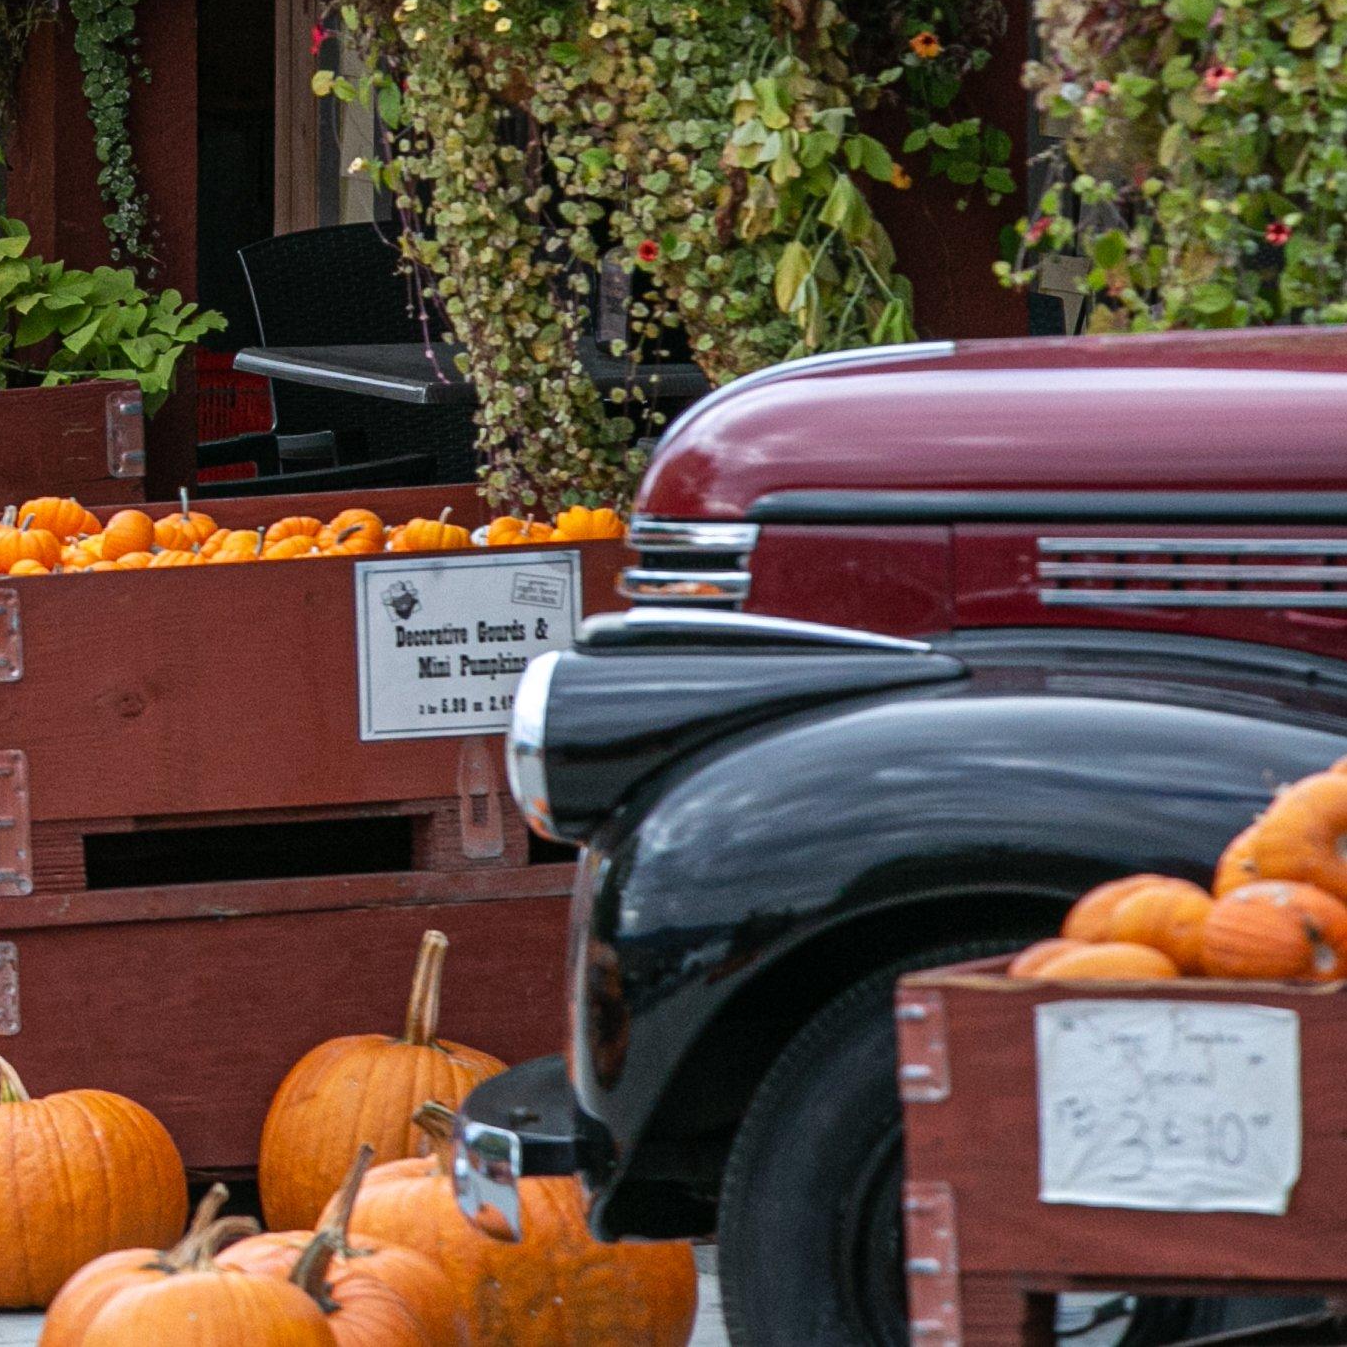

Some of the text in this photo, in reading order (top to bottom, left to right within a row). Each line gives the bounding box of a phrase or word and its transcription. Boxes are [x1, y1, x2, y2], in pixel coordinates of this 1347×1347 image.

[395, 616, 549, 648] Decorative Gourds &
[418, 651, 529, 680] Mini Pumpkins
